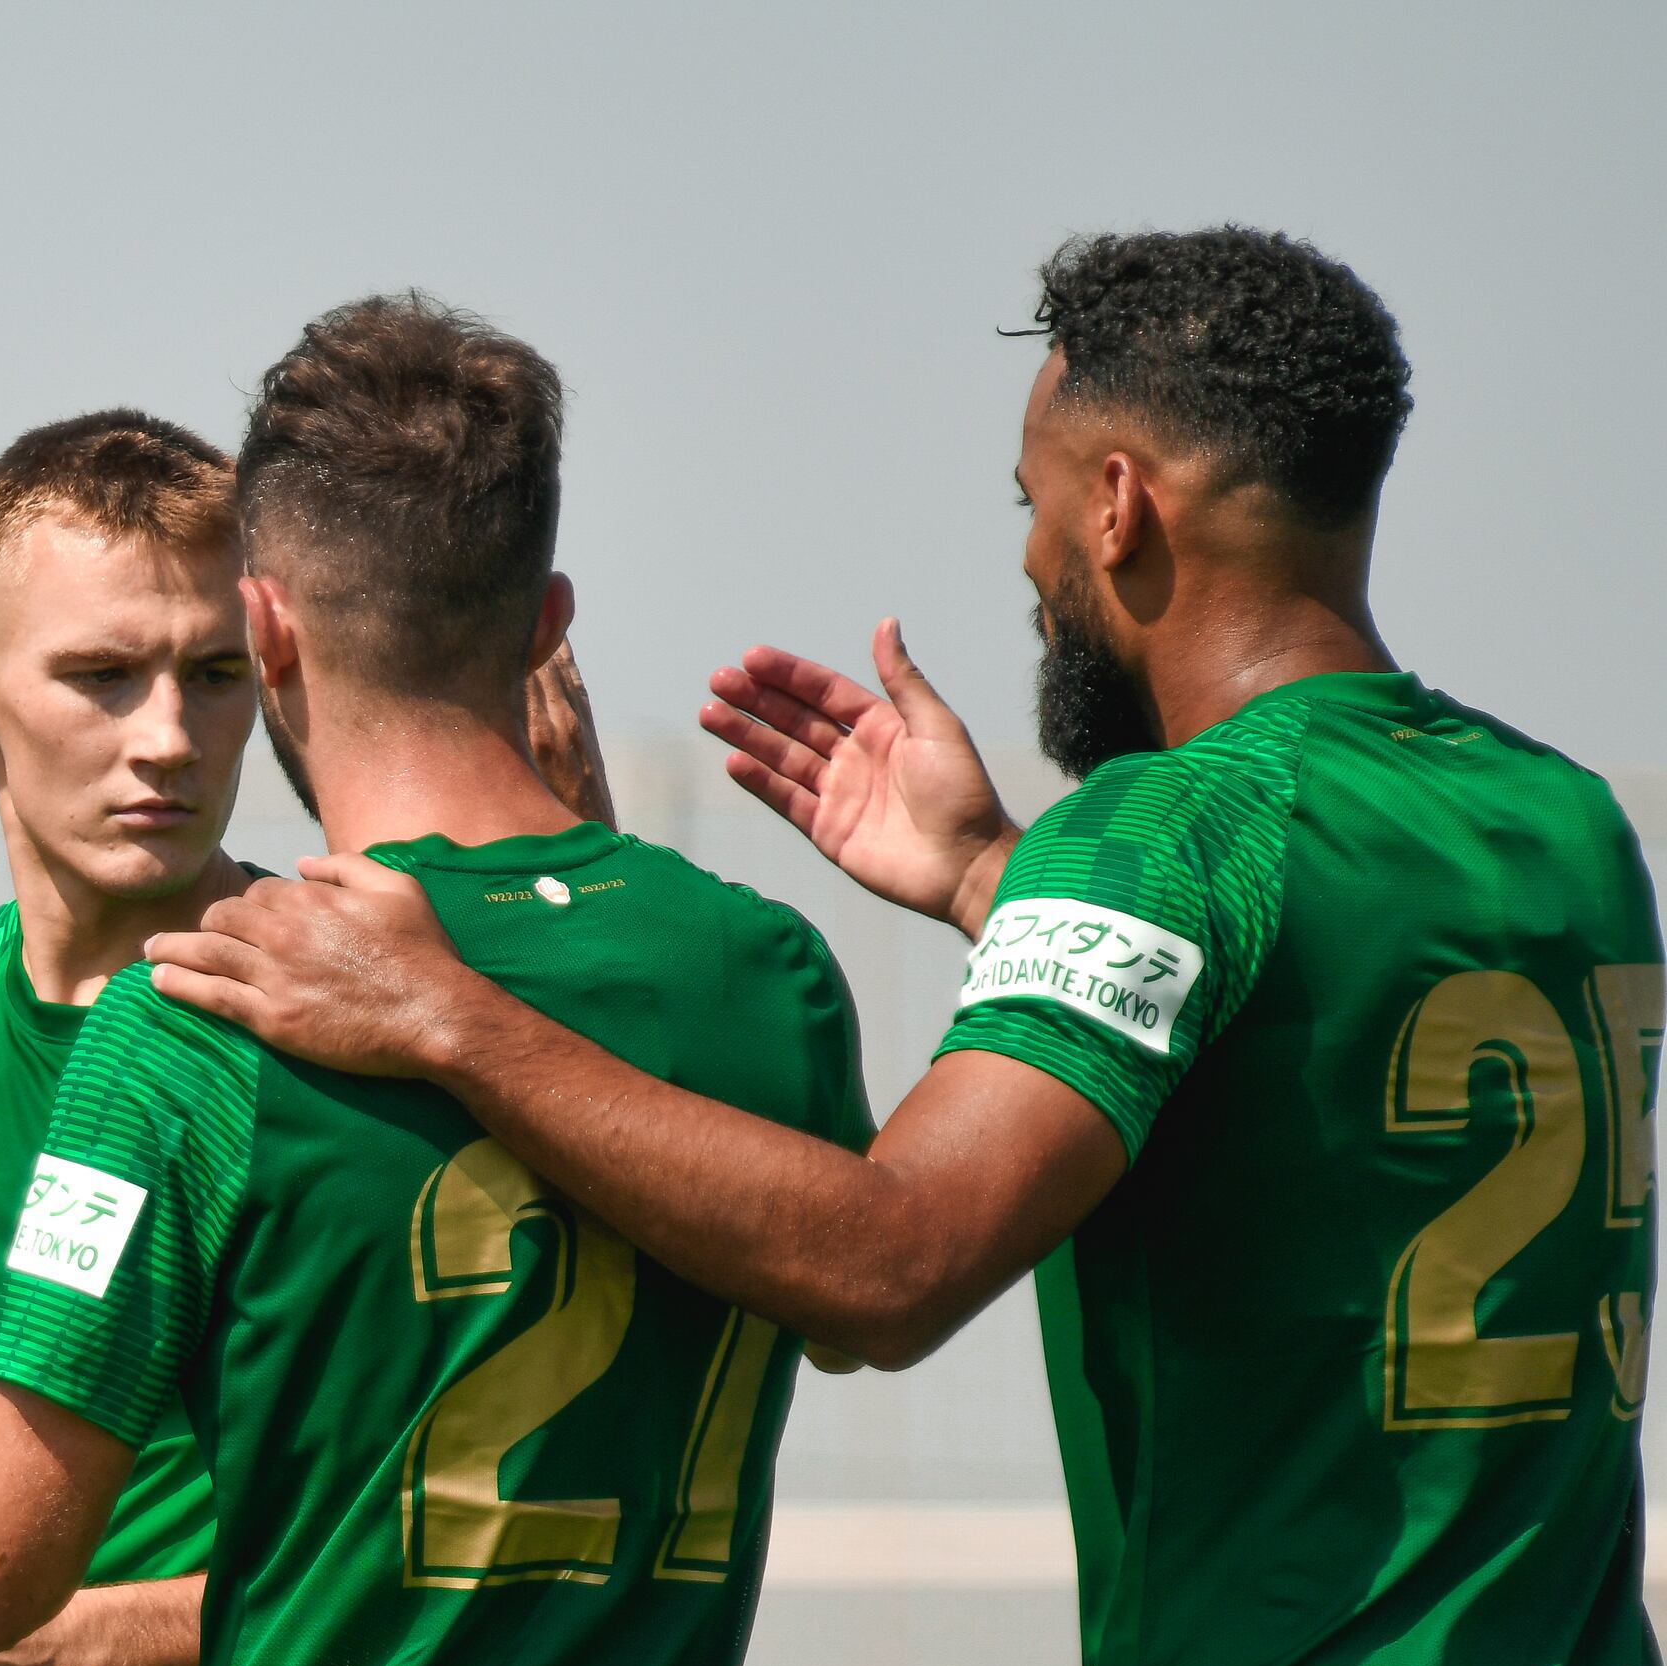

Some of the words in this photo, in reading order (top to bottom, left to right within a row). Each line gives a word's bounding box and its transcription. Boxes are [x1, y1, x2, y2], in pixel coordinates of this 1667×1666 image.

[484, 890, 534, 904] 1922/23
[577, 878, 627, 894] 2022/23
[980, 914, 1182, 984] スフィダンテ
